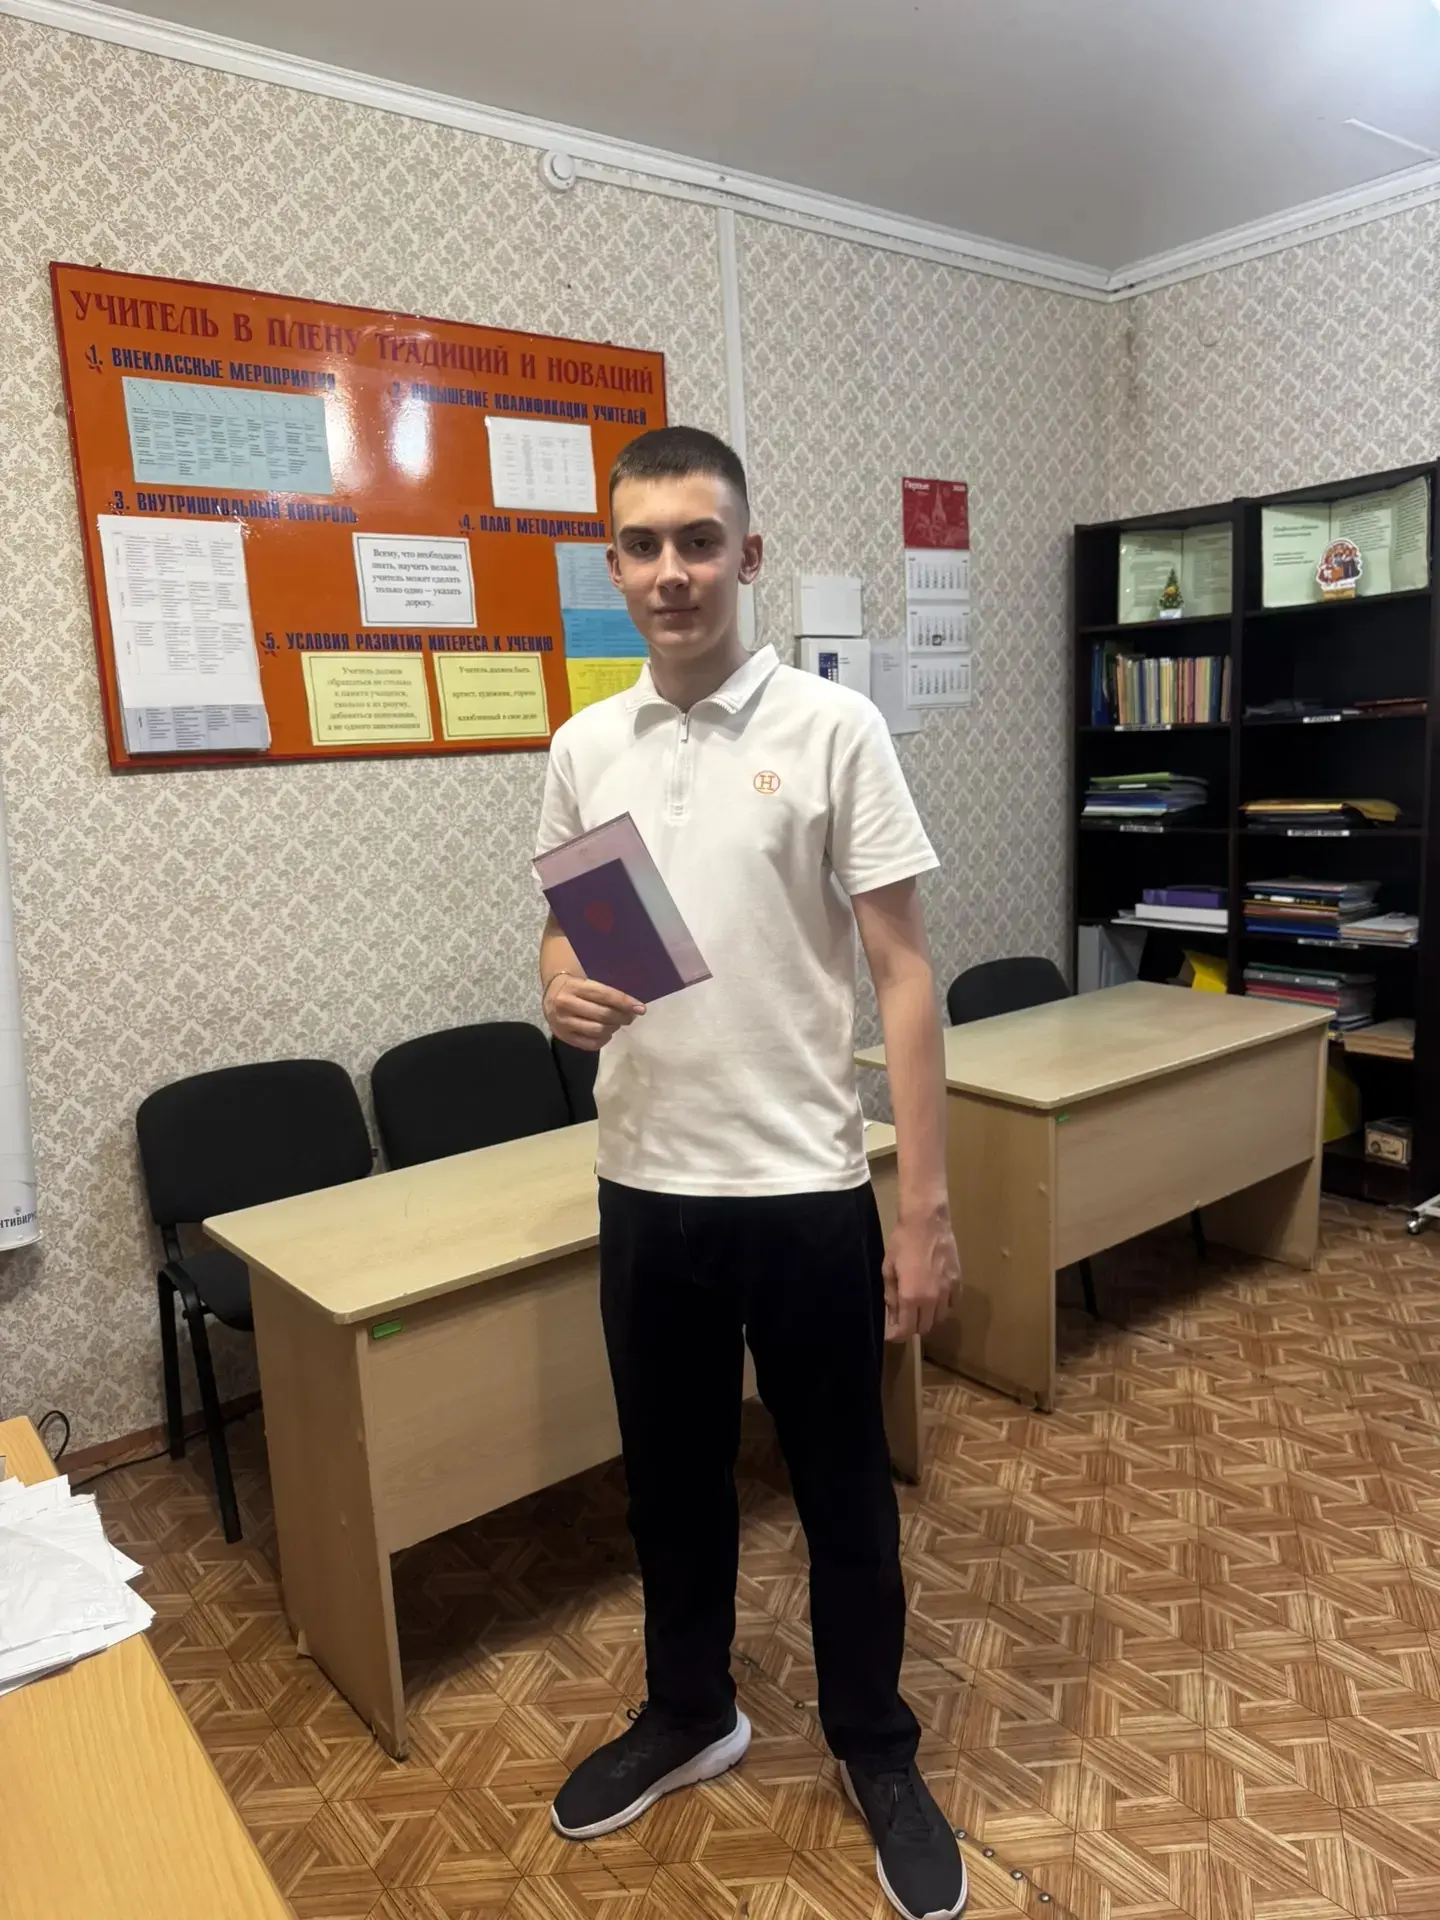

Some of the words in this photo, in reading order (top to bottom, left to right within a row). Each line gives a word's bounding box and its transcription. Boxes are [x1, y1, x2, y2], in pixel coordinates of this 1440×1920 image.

[71, 290, 219, 338] УЧИТЕЛЬ
[233, 312, 253, 342] В
[268, 317, 361, 356] ПЛЕНУ
[375, 333, 509, 378] ТРАДИЦИЙ
[521, 353, 536, 379] И
[548, 356, 654, 395] НОВАЦИЙ
[88, 344, 103, 366] 1.
[112, 347, 223, 379] ВНЕКЛАССНЫЕ
[229, 362, 336, 390] МЕРОПРИЯТИЯ
[411, 382, 489, 409] ПОВЫШЕНИЕ
[495, 393, 589, 420] КВАЛИФИКАЦИИ
[593, 403, 647, 426] УЧИТЕЛЕЙ
[114, 490, 130, 511] 3.
[137, 491, 281, 520] ВНУТРИШКОЛЬНЫЙ
[287, 503, 358, 524] КОНТРОЛЬ
[462, 514, 475, 531] 4.
[480, 515, 512, 533] ПЛАН
[517, 517, 606, 538] МЕТОДИЧЕСКОЙ
[265, 632, 280, 650] 5.
[286, 632, 350, 651] УСЛОВИЯ
[356, 633, 423, 652] РАЗВИТИЯ
[428, 634, 488, 652] ИНТЕРЕСА
[492, 635, 502, 652] К
[507, 634, 554, 652] УЧЕНИЮ
